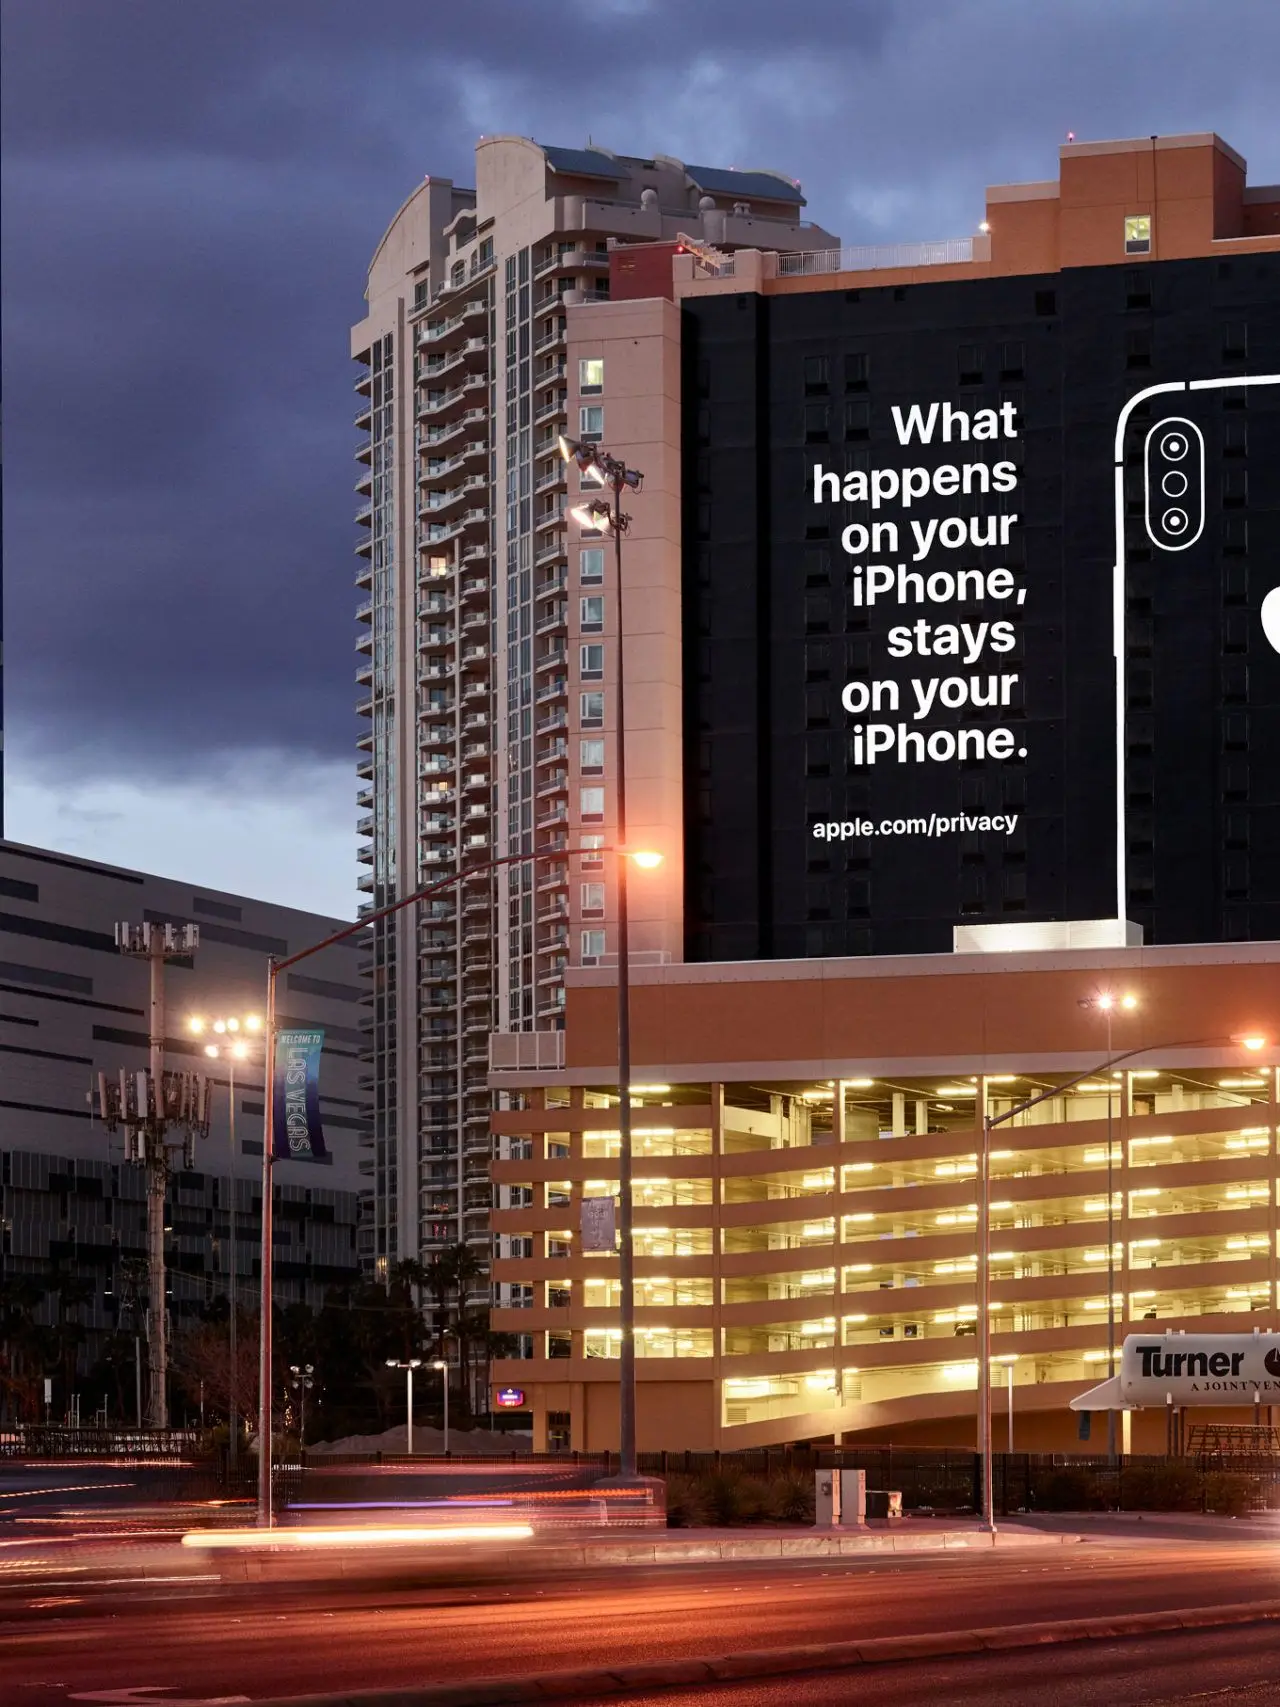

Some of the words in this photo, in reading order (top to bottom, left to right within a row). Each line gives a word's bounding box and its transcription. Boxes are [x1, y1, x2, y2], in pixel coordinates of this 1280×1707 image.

[891, 402, 1018, 445] What
[813, 460, 1018, 509] happens
[841, 521, 899, 555] on
[910, 513, 1018, 561] your
[853, 564, 1027, 606] iPhone,
[887, 618, 1016, 664] stays
[841, 680, 899, 713] on
[910, 673, 1018, 719] your
[853, 723, 1028, 766] iPhone.
[812, 813, 1018, 842] apple.com/privacy
[281, 1035, 311, 1044] WELCOME
[312, 1034, 321, 1043] TO
[287, 1047, 308, 1084] LAS
[286, 1088, 311, 1152] VEGAS
[1136, 1346, 1244, 1377] Turner
[1191, 1383, 1200, 1391] A
[1204, 1381, 1247, 1391] JOINT
